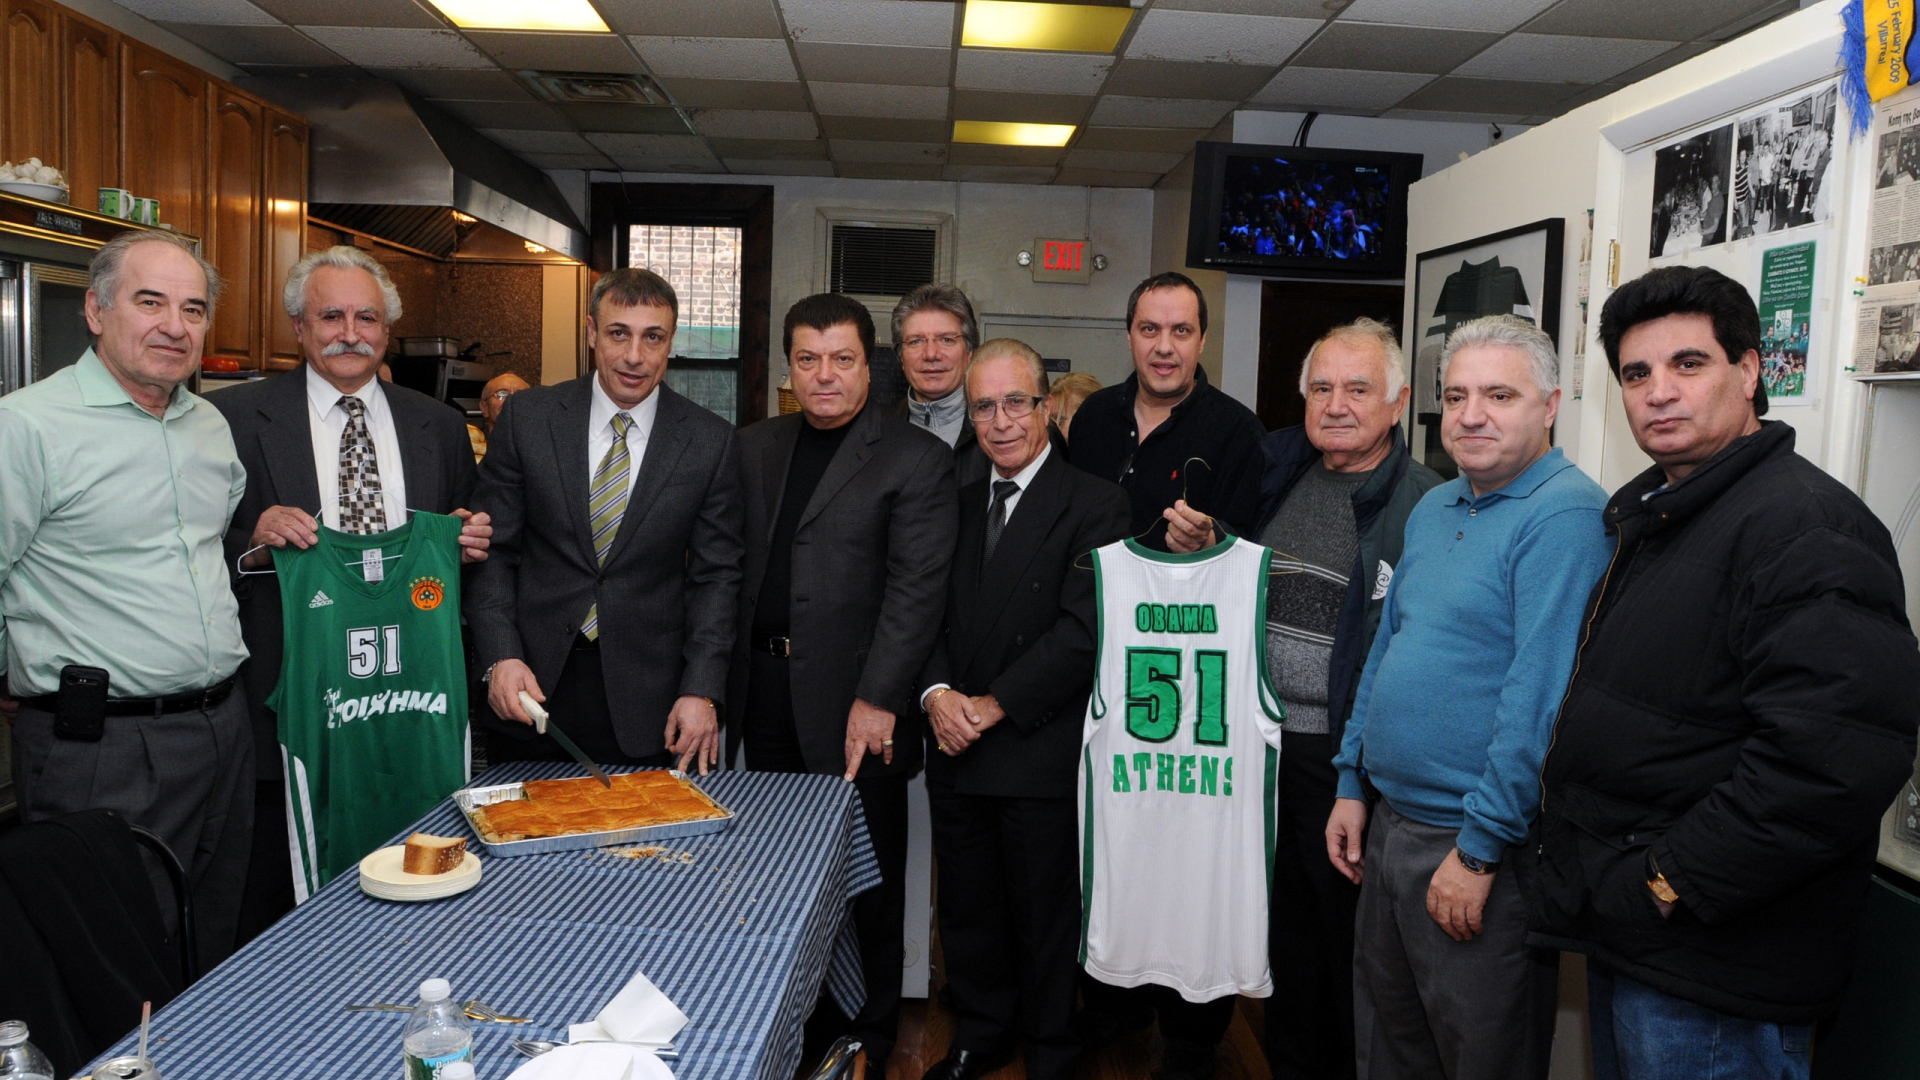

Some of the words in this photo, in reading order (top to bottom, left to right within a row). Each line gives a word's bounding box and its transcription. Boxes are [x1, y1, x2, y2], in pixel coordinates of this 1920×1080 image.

[1877, 20, 1889, 65] Villarreal
[1890, 11, 1903, 54] February
[1889, 57, 1903, 83] 2009
[1044, 241, 1085, 271] EXIT
[309, 599, 334, 609] adidas
[1135, 602, 1219, 634] OBAMA
[346, 624, 401, 679] 51
[1125, 646, 1229, 748] 51
